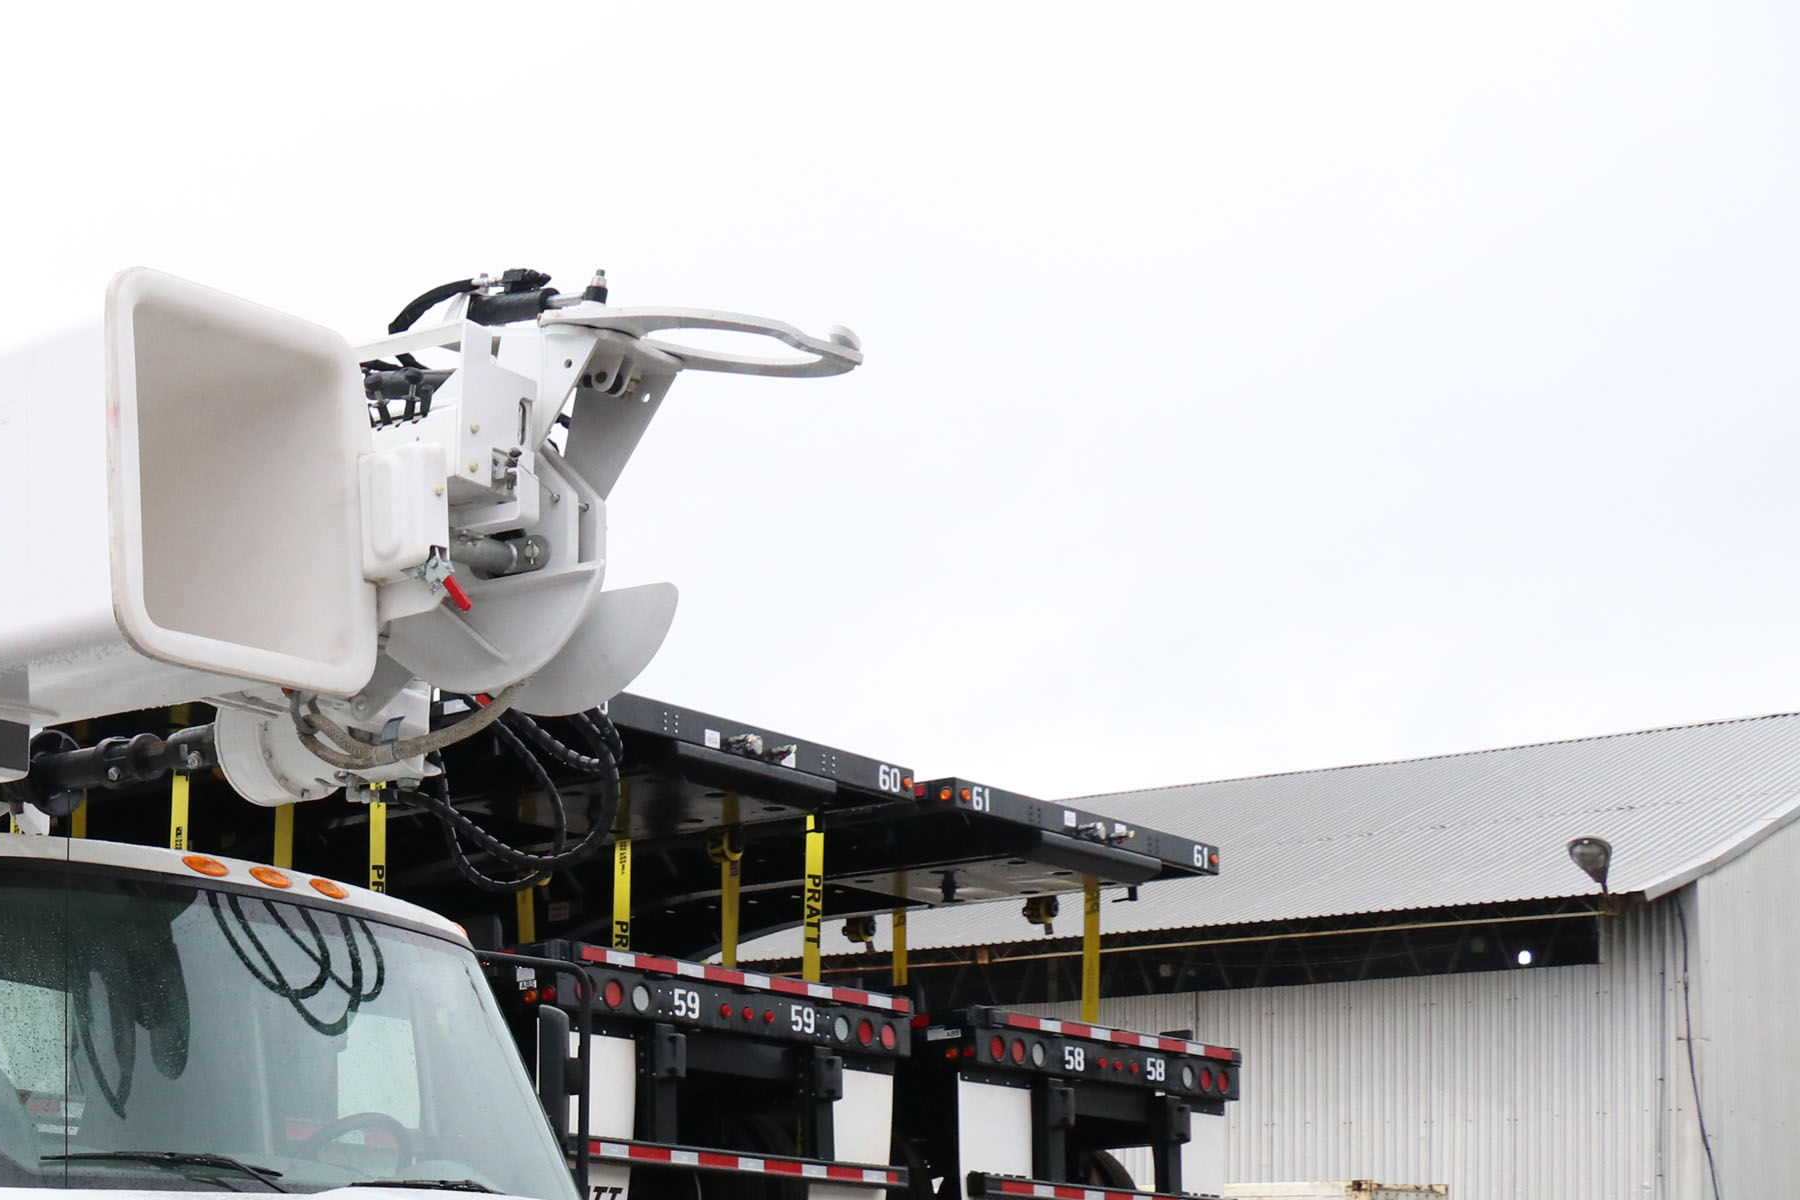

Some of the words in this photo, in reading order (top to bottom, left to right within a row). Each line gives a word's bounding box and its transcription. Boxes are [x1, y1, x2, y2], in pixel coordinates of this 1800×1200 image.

[879, 765, 901, 793] 60
[972, 786, 990, 812] 61
[1193, 844, 1209, 868] 61
[804, 873, 822, 949] PRATT
[673, 988, 700, 1020] 59
[790, 1004, 816, 1034] 59
[1064, 1046, 1085, 1072] 58
[1146, 1057, 1165, 1082] 58
